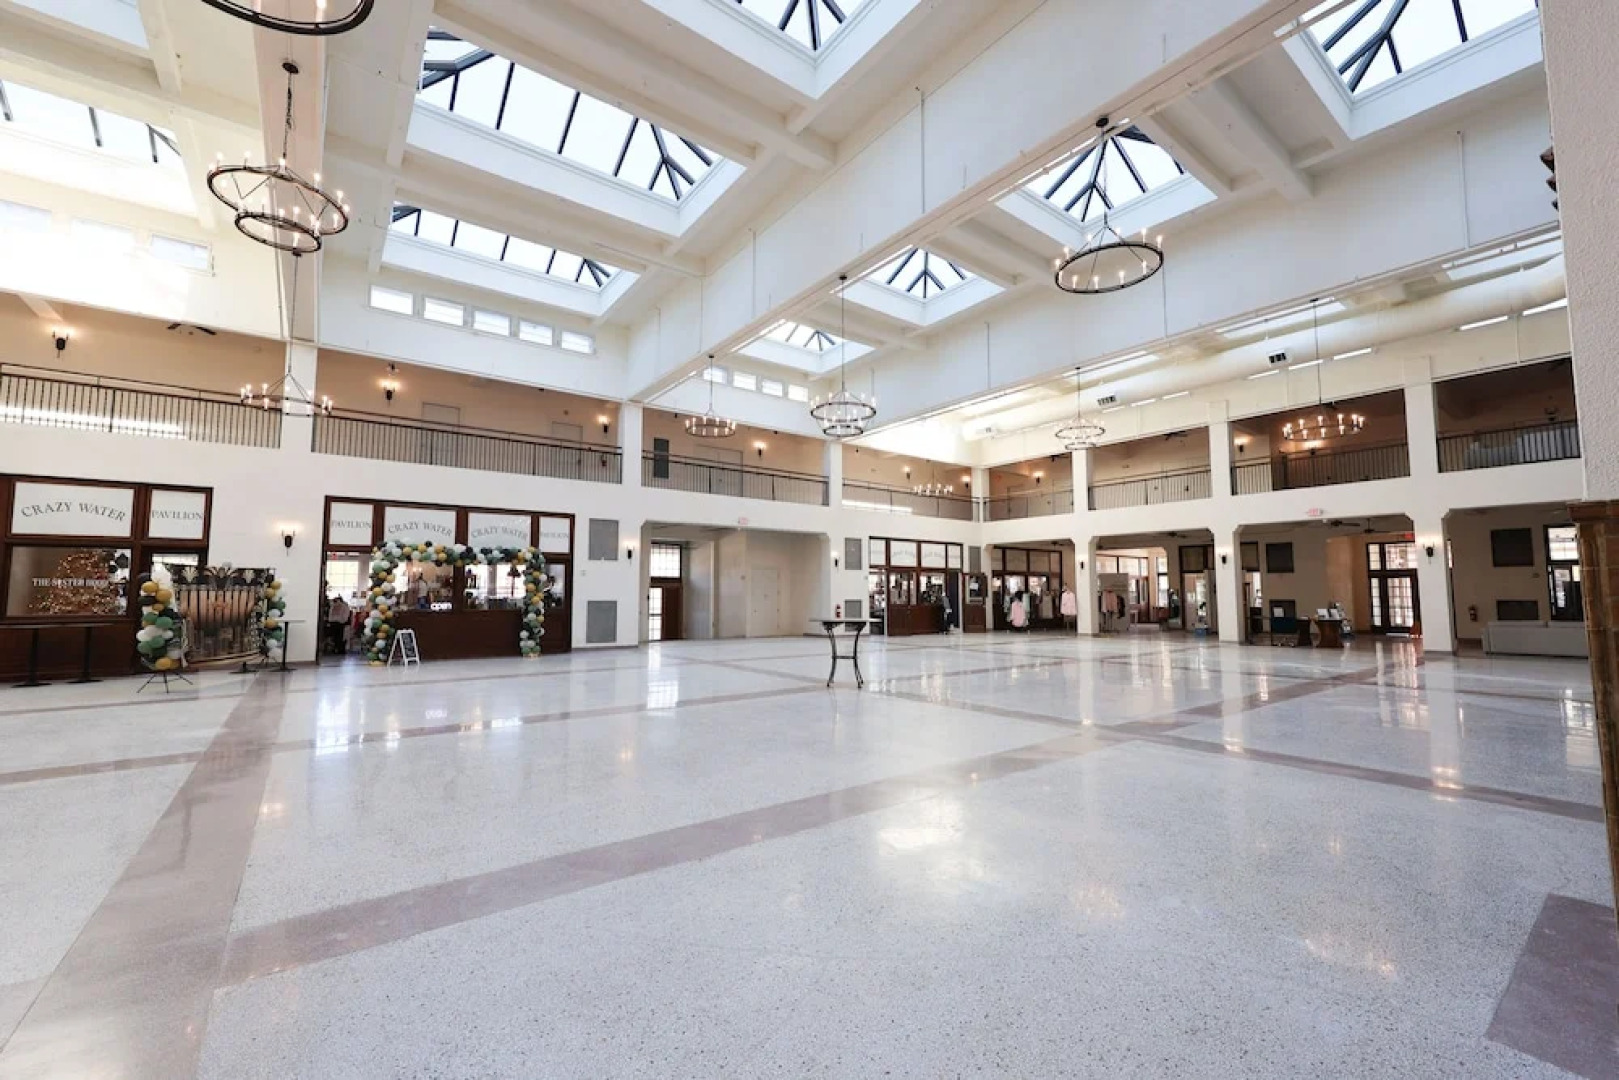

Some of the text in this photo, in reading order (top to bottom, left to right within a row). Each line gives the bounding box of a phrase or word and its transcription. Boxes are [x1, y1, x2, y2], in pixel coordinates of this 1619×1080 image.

[20, 501, 126, 522] CRAZY WATER
[151, 509, 203, 521] PAVILION
[388, 522, 453, 537] CRAZY WATER
[32, 577, 51, 587] THE
